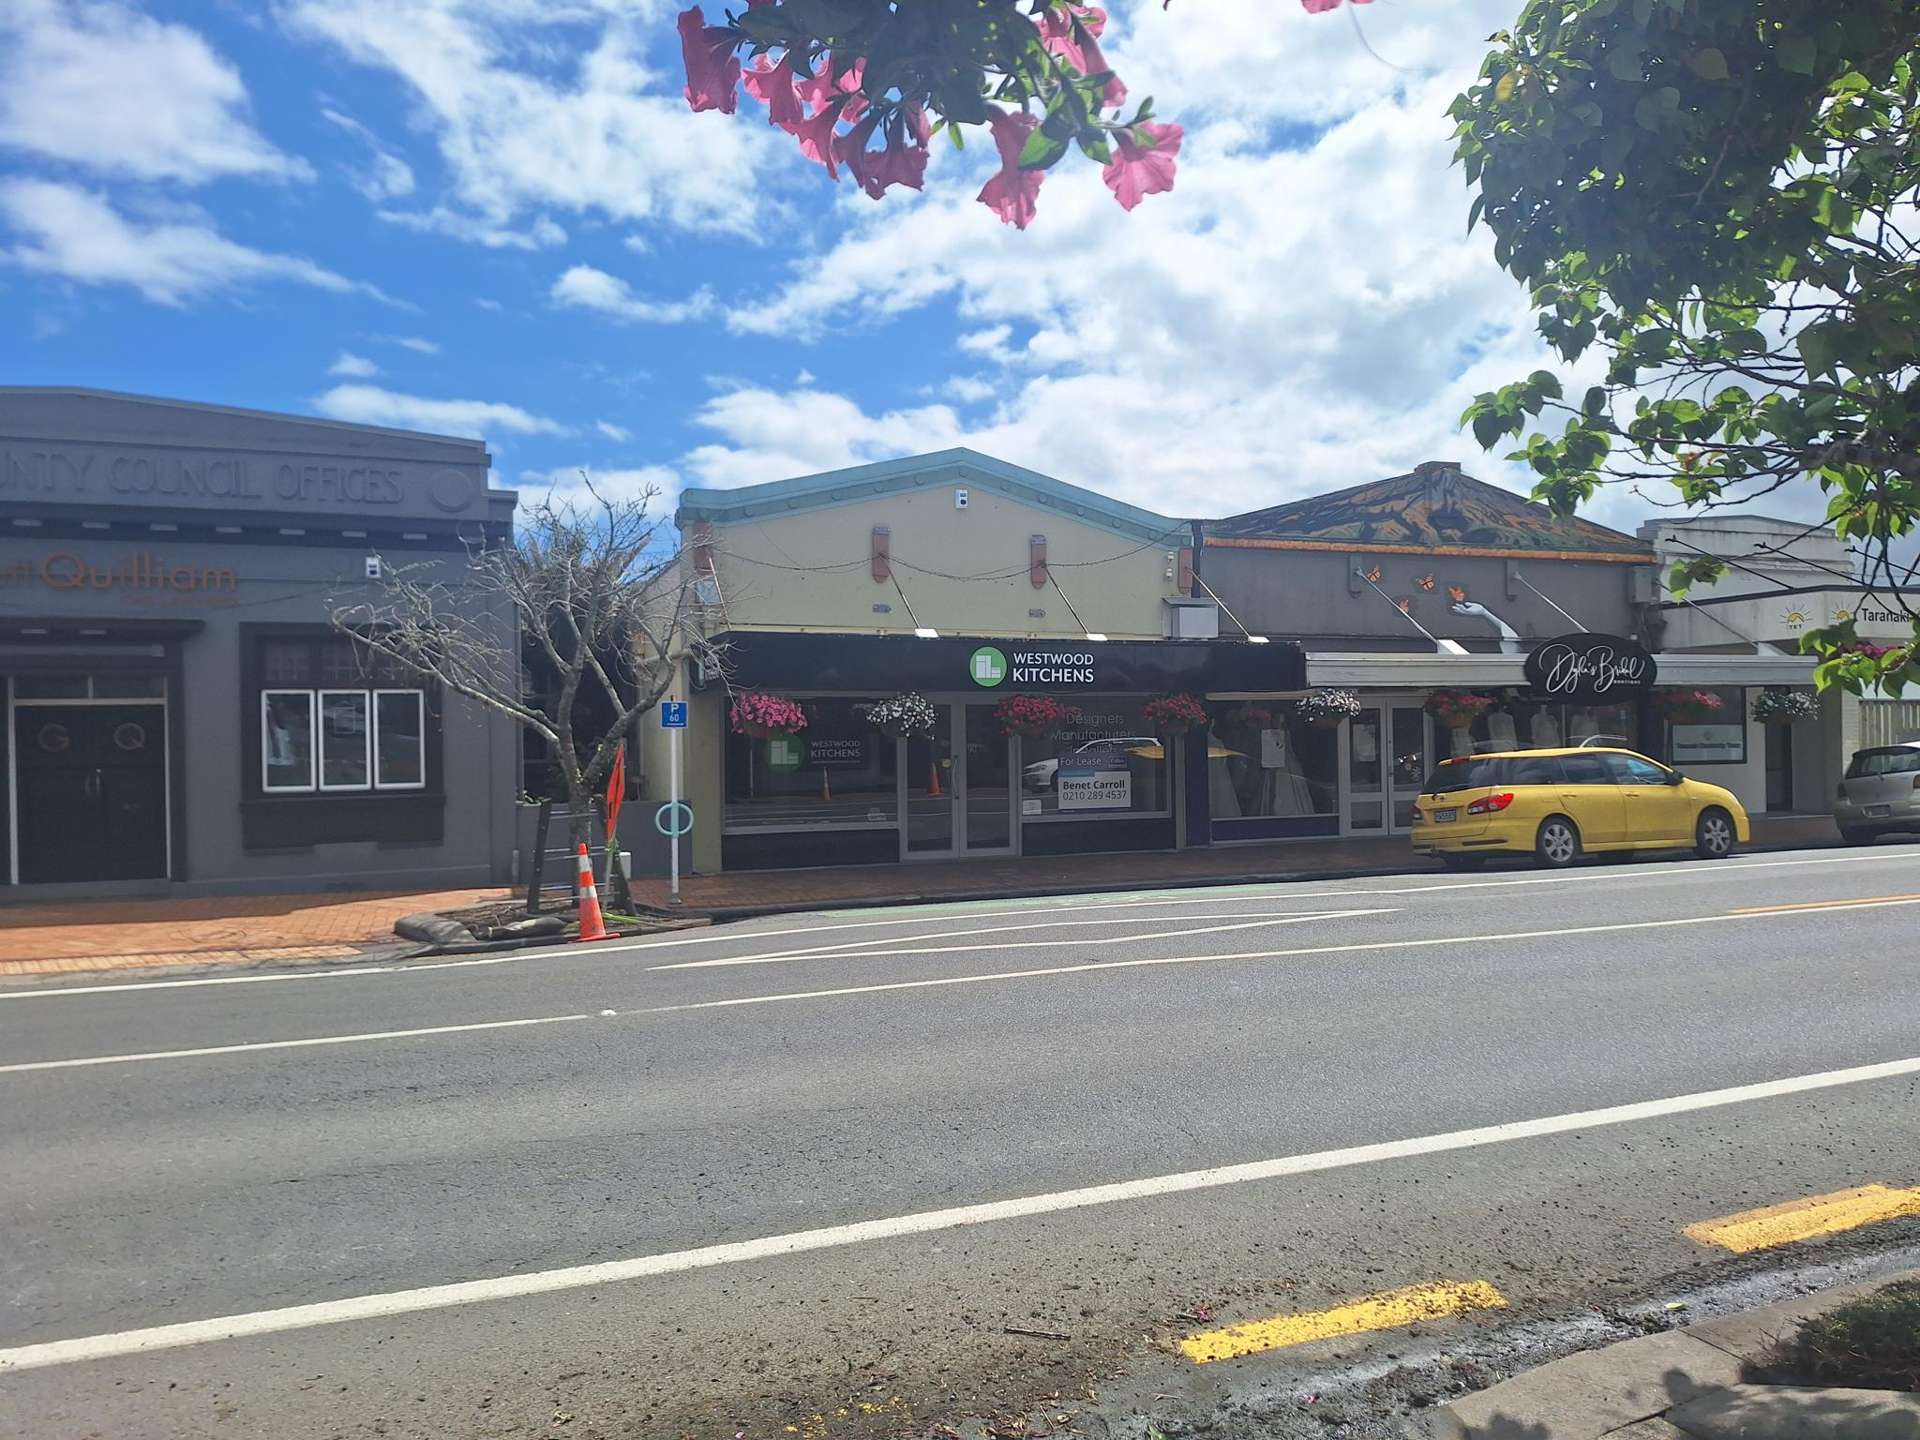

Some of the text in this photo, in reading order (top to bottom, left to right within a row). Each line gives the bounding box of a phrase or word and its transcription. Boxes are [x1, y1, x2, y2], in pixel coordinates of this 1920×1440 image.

[110, 456, 262, 498] COUNCIL
[273, 464, 404, 504] OFFICES
[41, 551, 238, 592] Quilliam
[1862, 607, 1910, 623] Taranaki
[1013, 652, 1094, 665] WESTWOOD
[1012, 668, 1094, 683] KITCHENS
[671, 703, 680, 713] P
[811, 748, 861, 758] KITCHENS
[1060, 757, 1074, 766] For
[1077, 757, 1102, 766] Lease
[1063, 780, 1125, 790] Benet Carroll
[1063, 791, 1085, 800] 0210
[1087, 791, 1104, 799] 289
